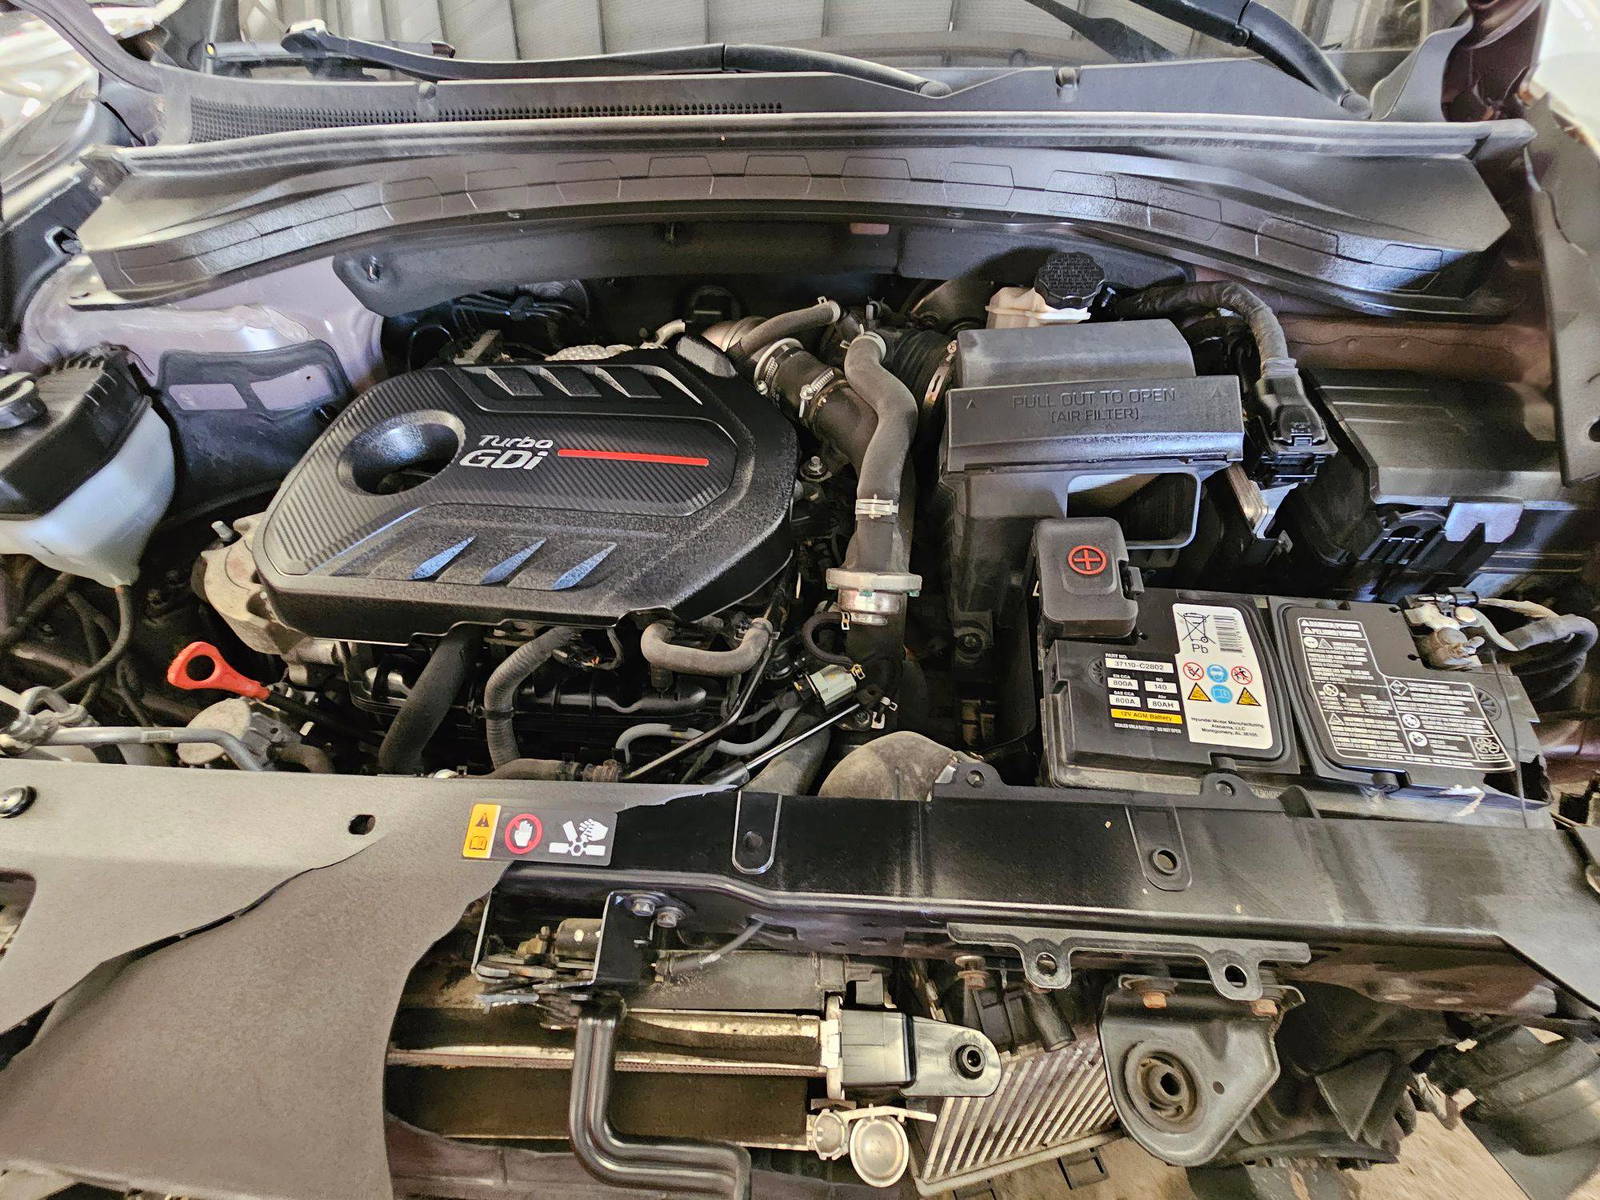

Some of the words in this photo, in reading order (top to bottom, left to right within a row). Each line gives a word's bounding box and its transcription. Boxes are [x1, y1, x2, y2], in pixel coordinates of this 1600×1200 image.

[1012, 394, 1056, 409] PULL
[1060, 391, 1096, 406] OUT
[1100, 390, 1125, 405] TO
[1129, 387, 1176, 403] OPEN
[478, 434, 554, 449] Turbo
[459, 449, 549, 470] GDi
[1192, 643, 1209, 654] Pb
[1115, 697, 1136, 705] 800A
[1152, 700, 1175, 708] 80AH
[1150, 713, 1172, 722] Battery
